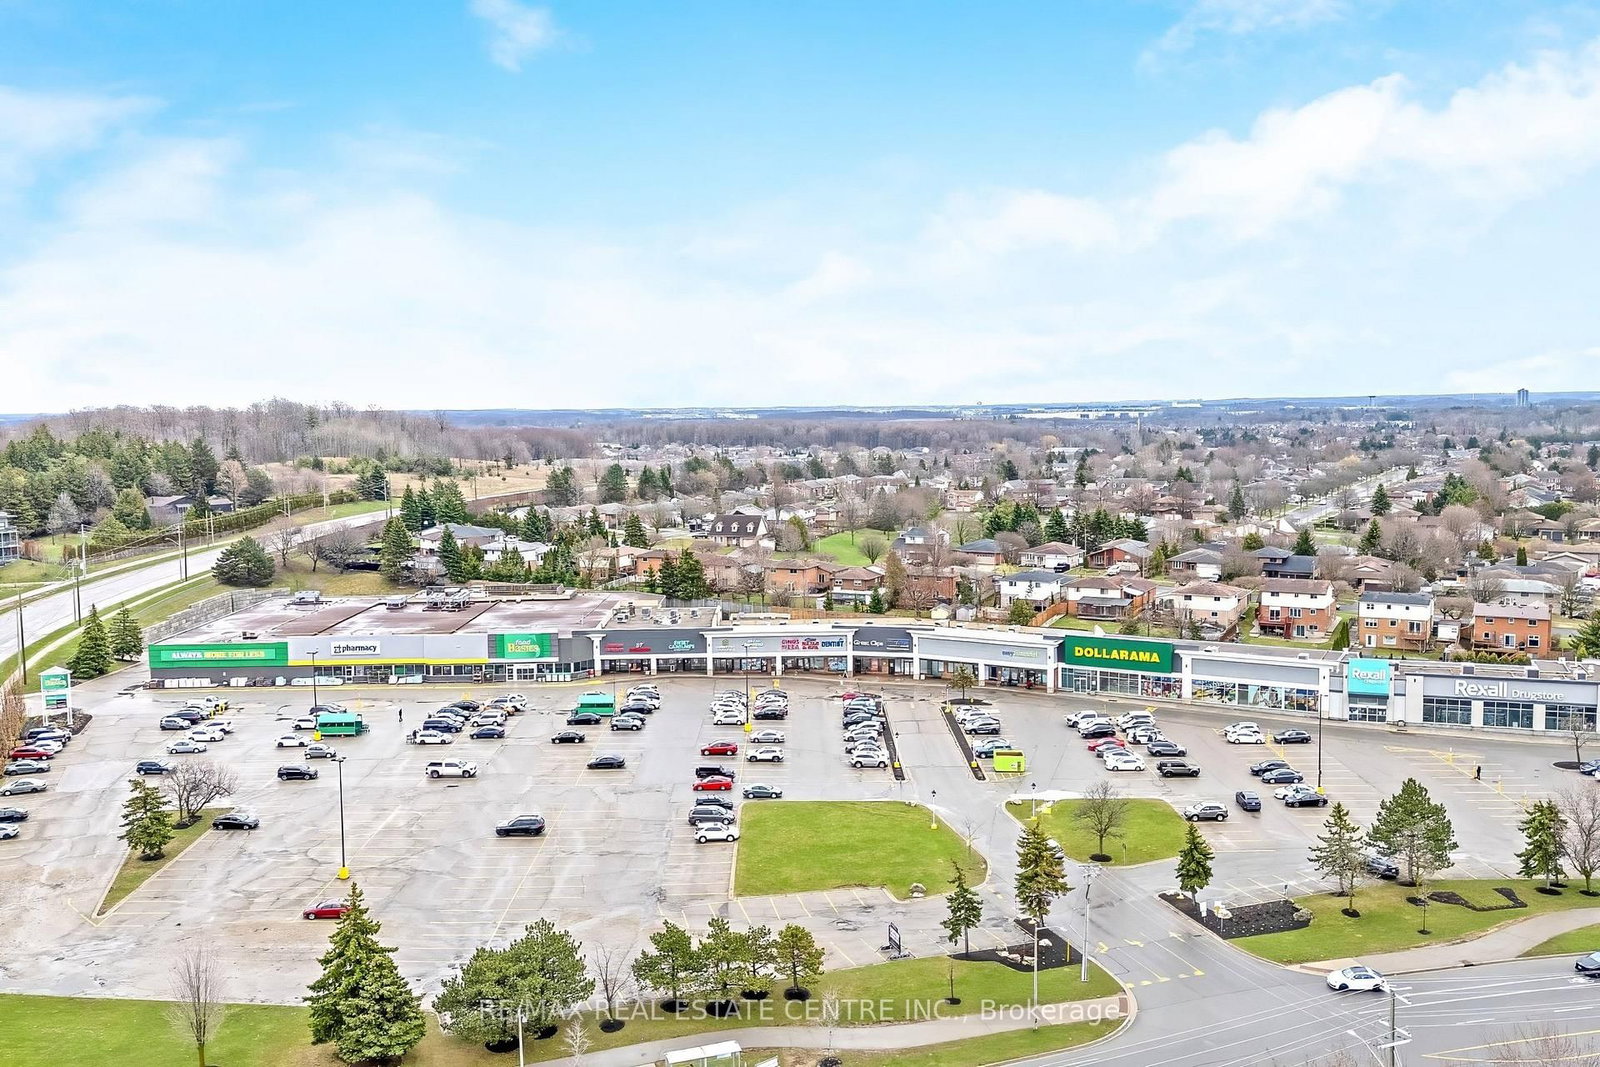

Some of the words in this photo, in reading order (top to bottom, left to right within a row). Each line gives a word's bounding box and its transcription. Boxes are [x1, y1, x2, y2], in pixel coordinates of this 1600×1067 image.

[342, 644, 377, 653] pharmacy
[1074, 646, 1160, 663] DOLLARAMA
[1353, 668, 1386, 681] Rexall
[1454, 679, 1508, 699] Rexall
[1511, 688, 1564, 701] Drugstore
